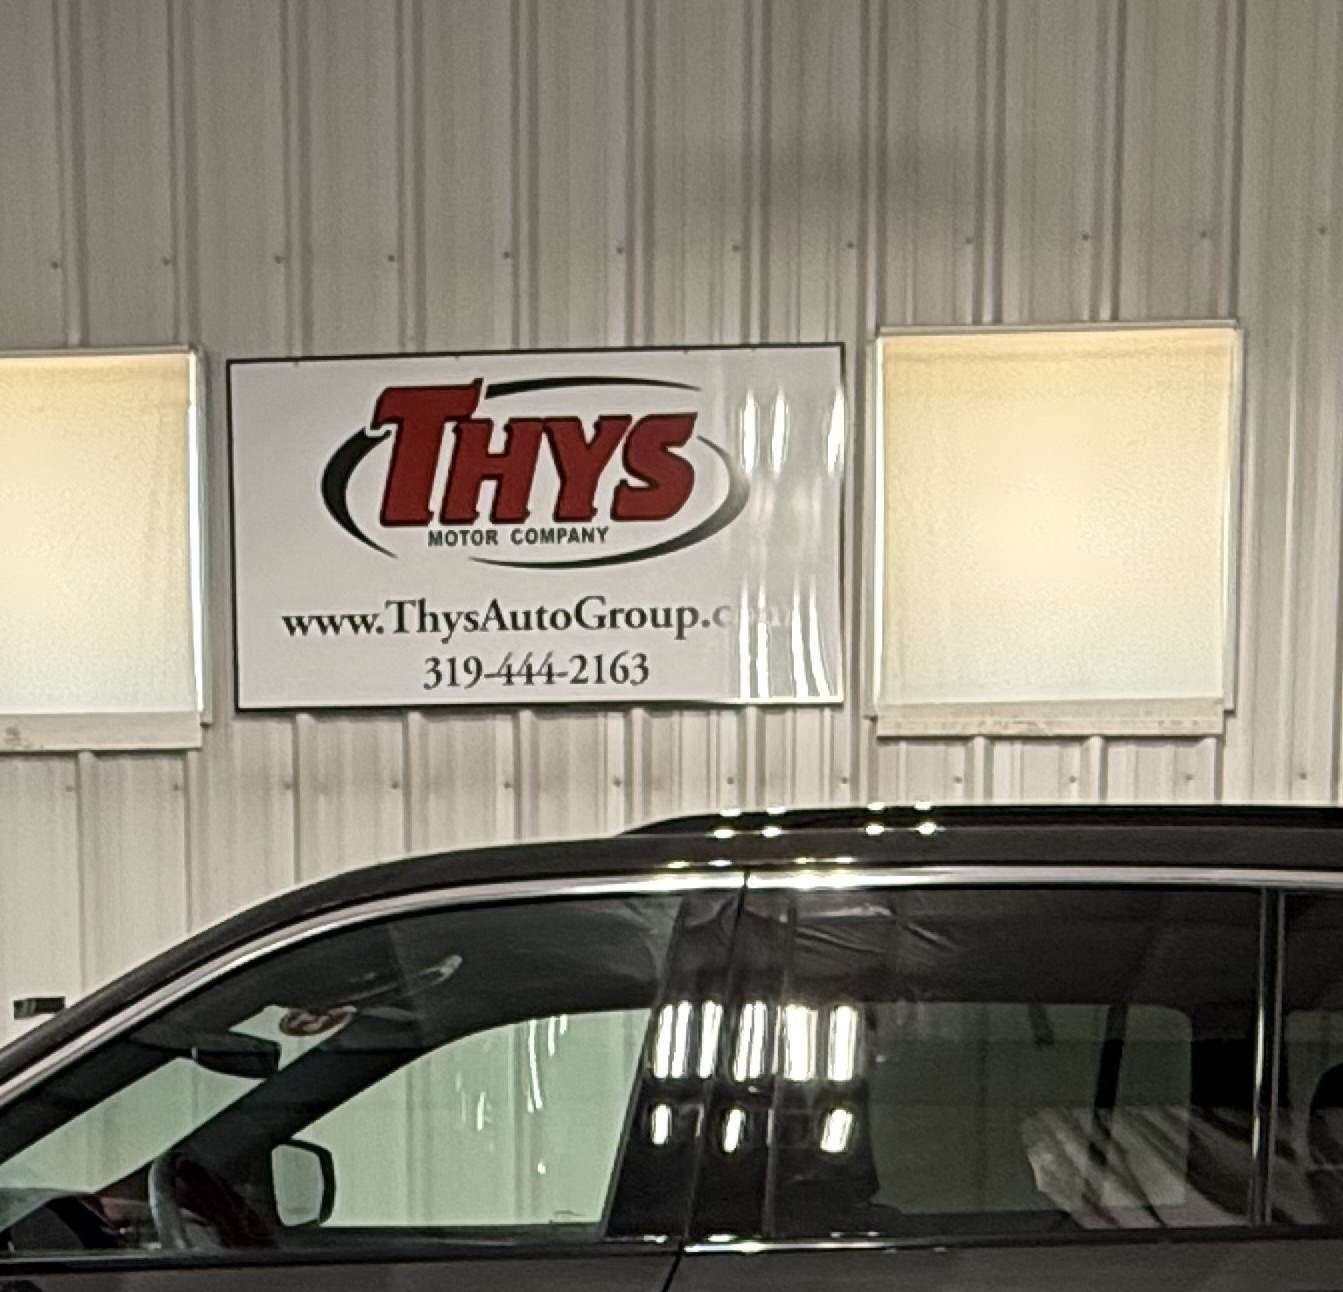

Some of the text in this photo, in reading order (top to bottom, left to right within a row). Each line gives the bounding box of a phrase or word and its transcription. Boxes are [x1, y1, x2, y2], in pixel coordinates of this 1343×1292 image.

[370, 378, 698, 526] THYS
[427, 525, 609, 547] MOTOR COMPANY
[281, 595, 793, 644] www.ThysAutoGroup.c
[423, 650, 650, 690] 319-444-2163
